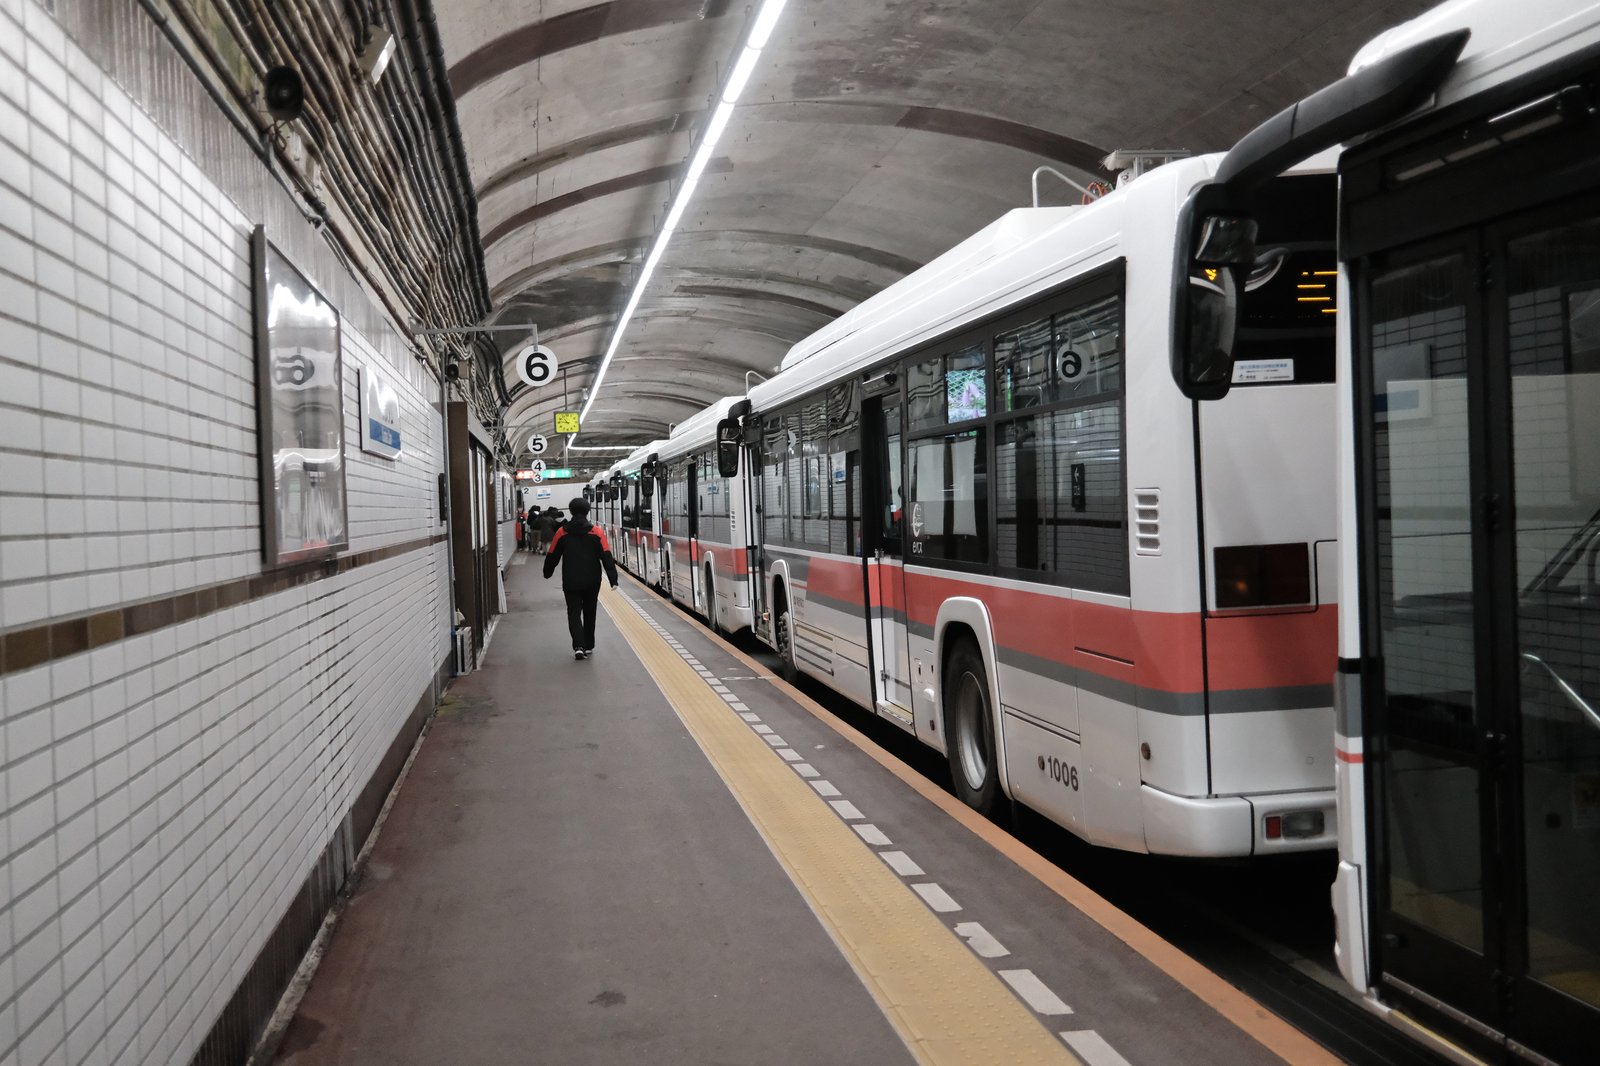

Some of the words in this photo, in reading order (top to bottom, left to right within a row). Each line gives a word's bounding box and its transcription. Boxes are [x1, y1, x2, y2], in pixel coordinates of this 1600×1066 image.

[526, 352, 549, 382] 6
[532, 437, 544, 452] 5
[534, 462, 542, 471] 4
[535, 474, 541, 482] 3
[1047, 755, 1079, 792] 1006
